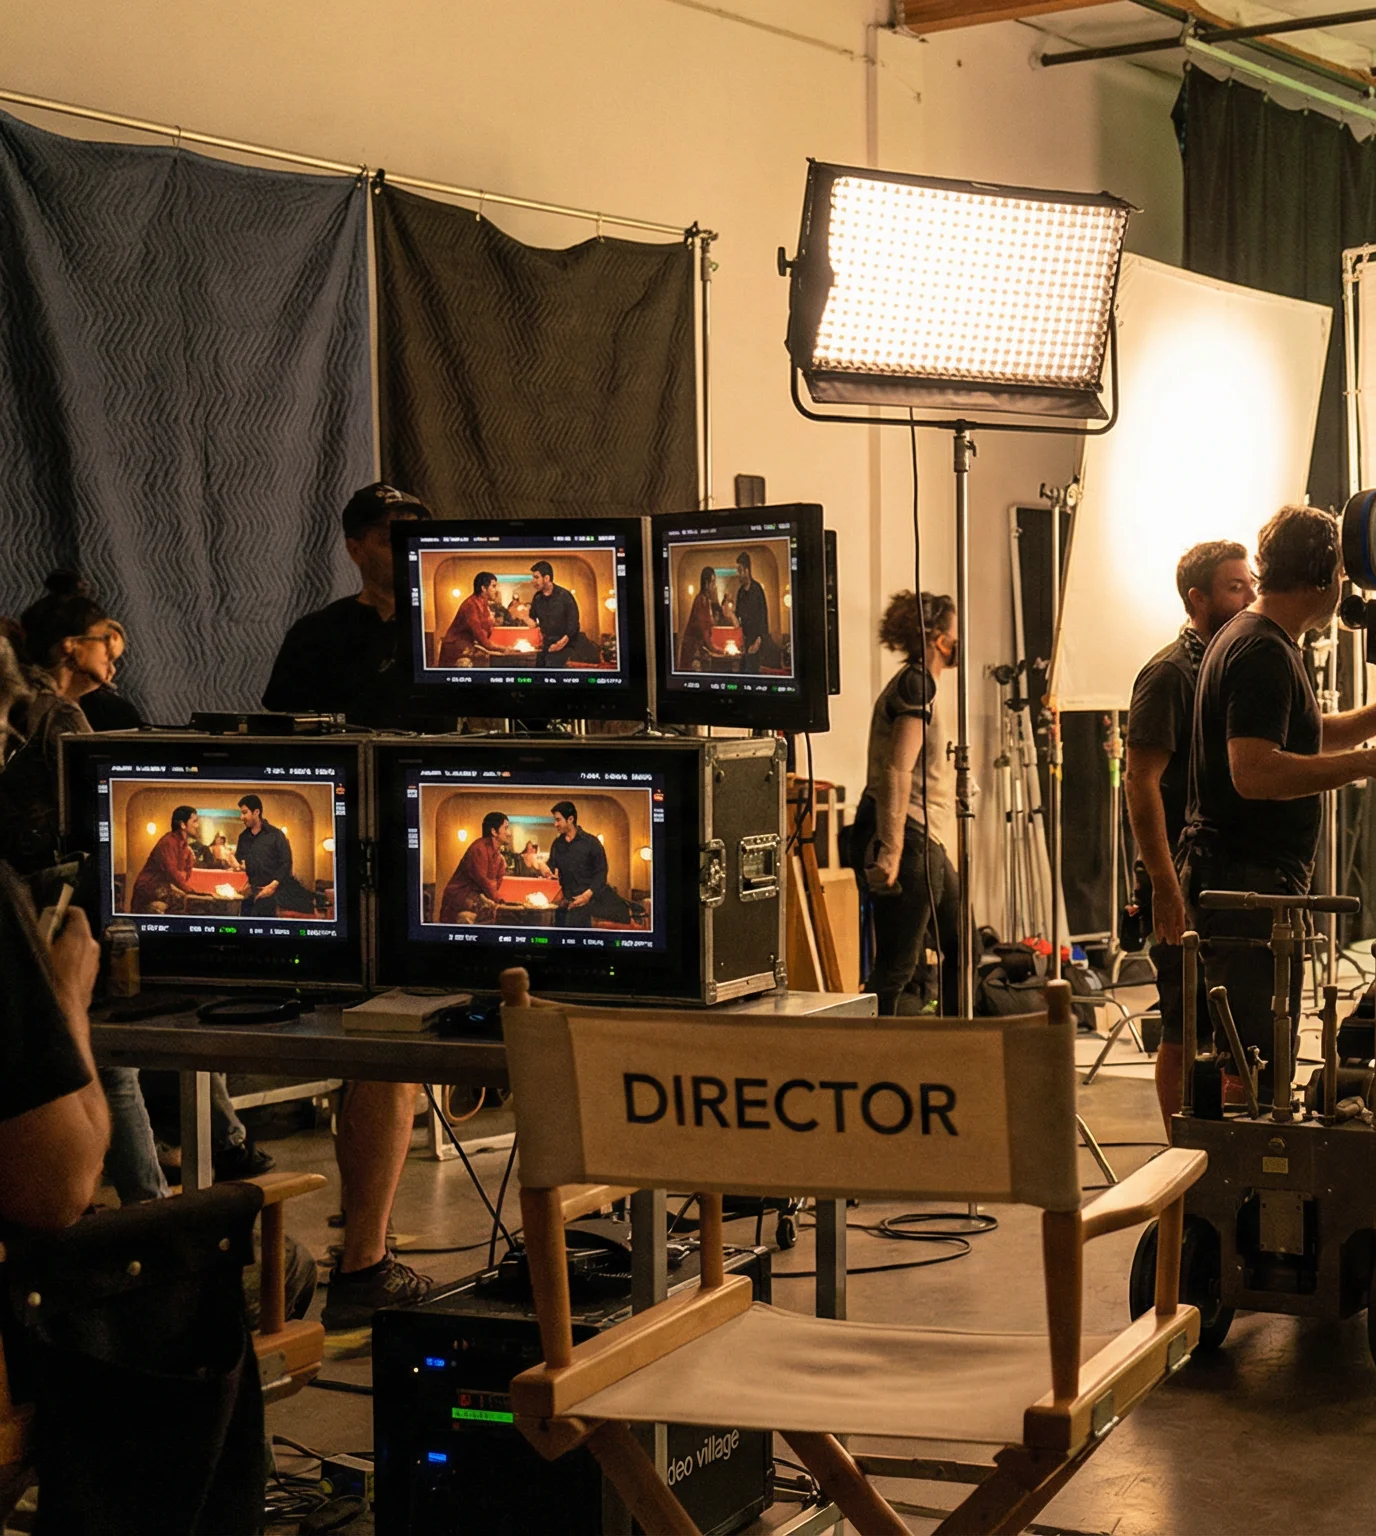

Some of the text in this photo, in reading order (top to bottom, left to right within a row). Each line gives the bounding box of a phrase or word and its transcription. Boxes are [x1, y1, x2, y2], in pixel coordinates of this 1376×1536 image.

[623, 1072, 960, 1136] DIRECTOR
[667, 1429, 740, 1486] deo village
